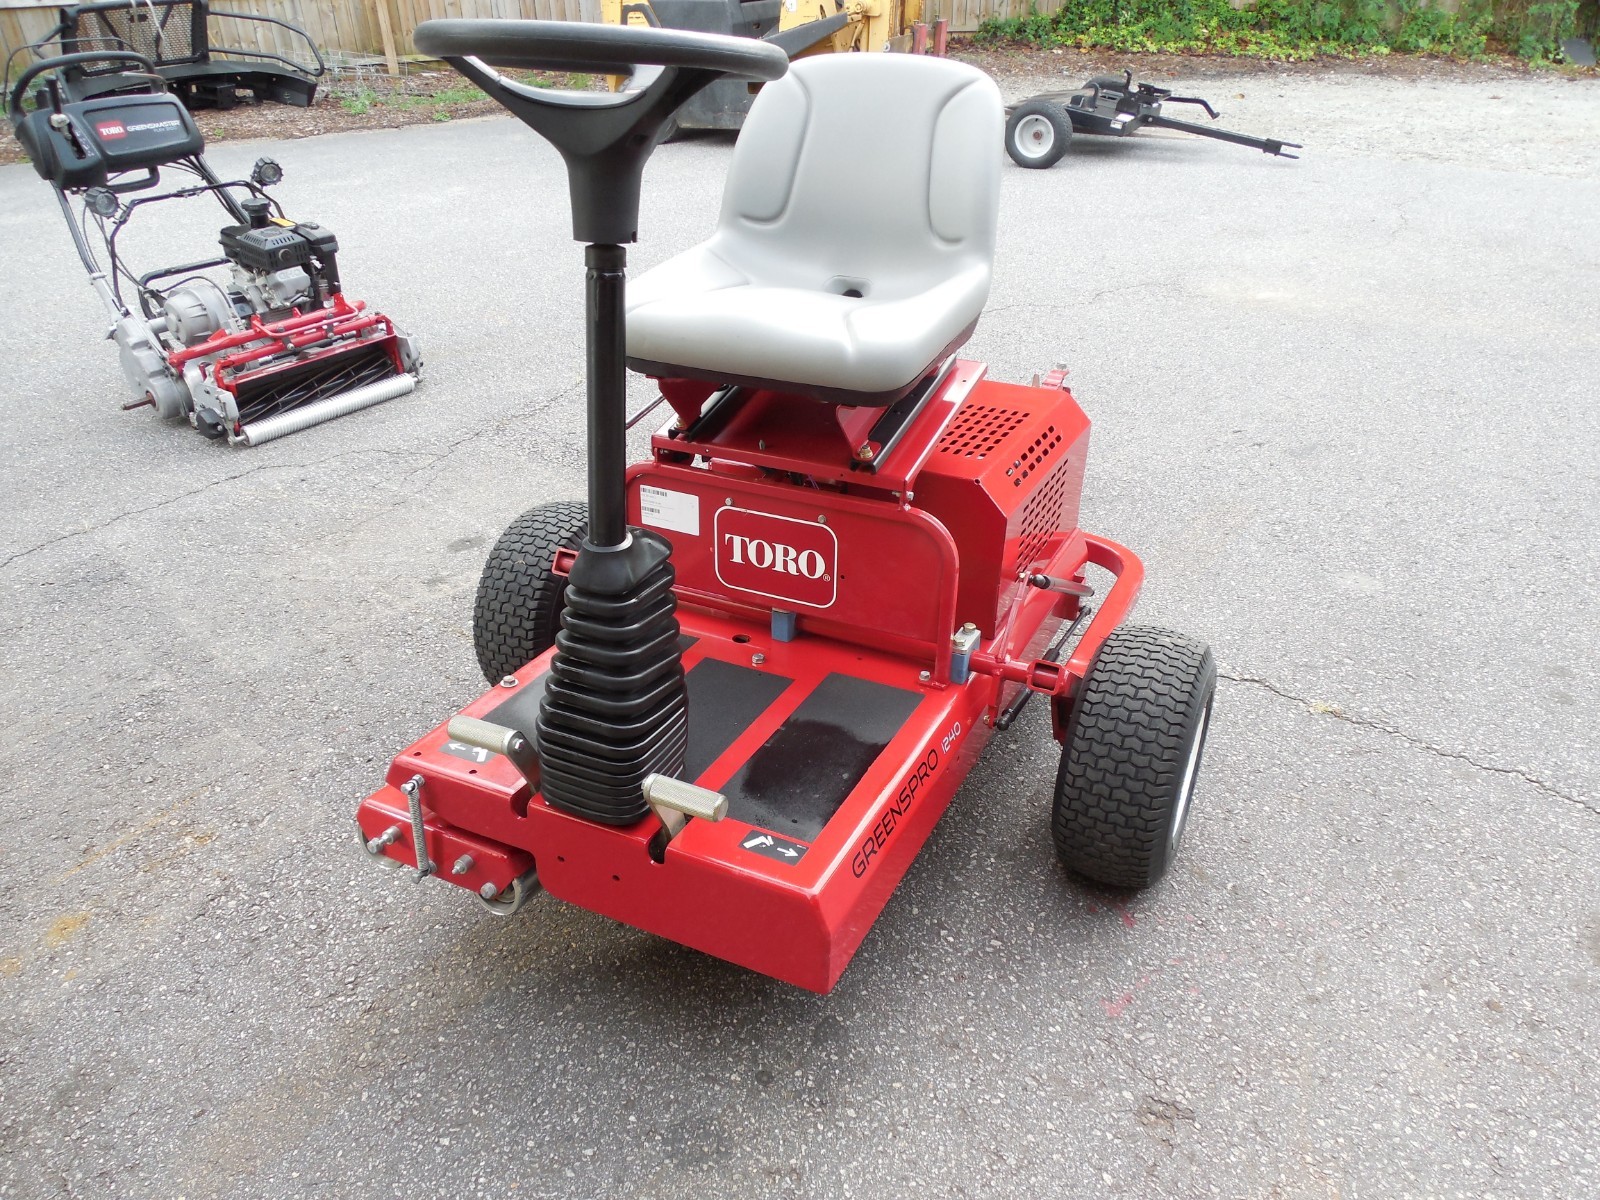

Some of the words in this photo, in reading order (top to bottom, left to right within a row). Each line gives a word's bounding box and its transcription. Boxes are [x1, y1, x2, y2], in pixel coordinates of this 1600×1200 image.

[99, 126, 125, 136] TORO
[126, 120, 181, 132] GREENSMASTER
[725, 533, 826, 580] TORO
[852, 748, 939, 879] GREENSPRO
[941, 721, 961, 755] 1240
